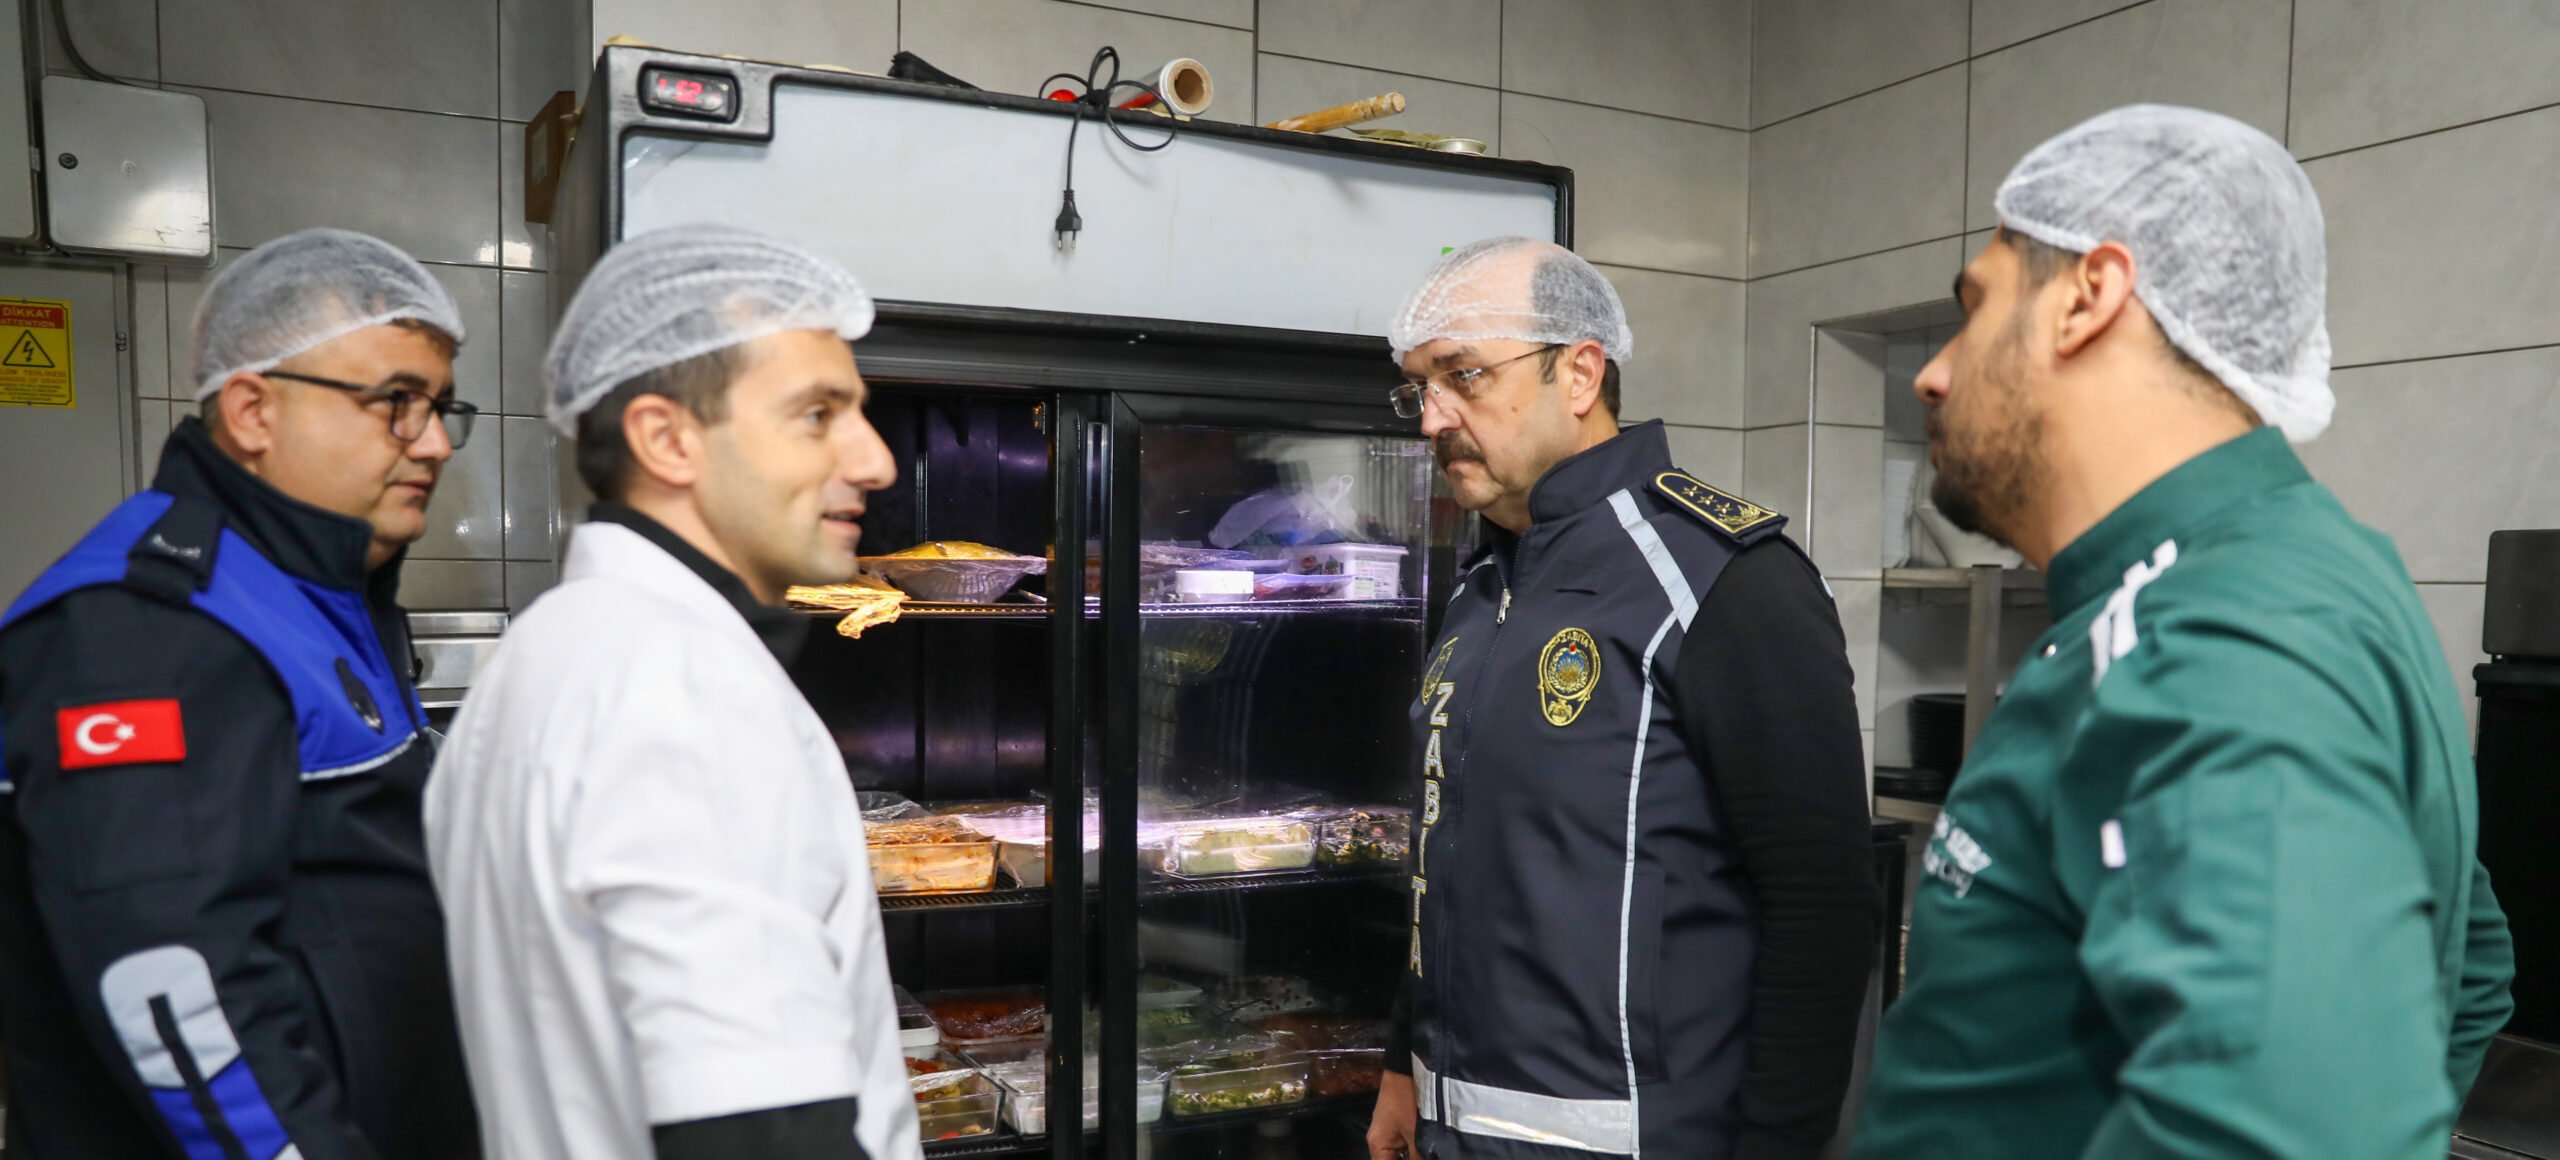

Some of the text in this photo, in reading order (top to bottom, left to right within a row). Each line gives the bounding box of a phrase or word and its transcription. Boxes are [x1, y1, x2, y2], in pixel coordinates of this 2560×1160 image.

[2, 305, 52, 319] DİKKAT
[0, 318, 56, 328] ATTENTION
[1410, 681, 1456, 979] ZABITA
